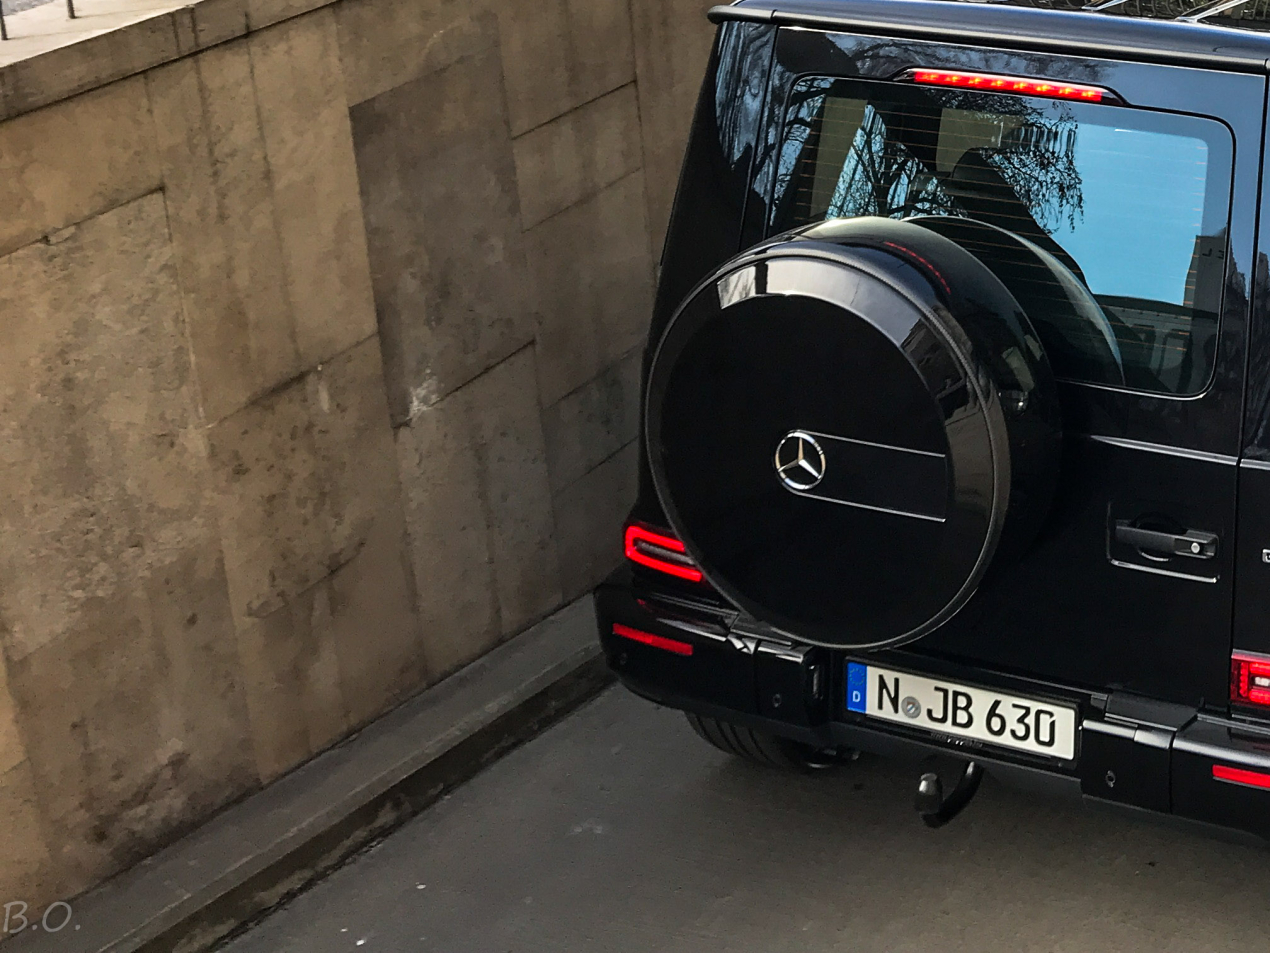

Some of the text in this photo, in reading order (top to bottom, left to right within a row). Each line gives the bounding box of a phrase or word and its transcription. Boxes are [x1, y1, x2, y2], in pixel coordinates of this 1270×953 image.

[852, 691, 861, 703] D
[877, 674, 900, 714] N
[926, 686, 974, 729] JB
[985, 699, 1056, 748] 630
